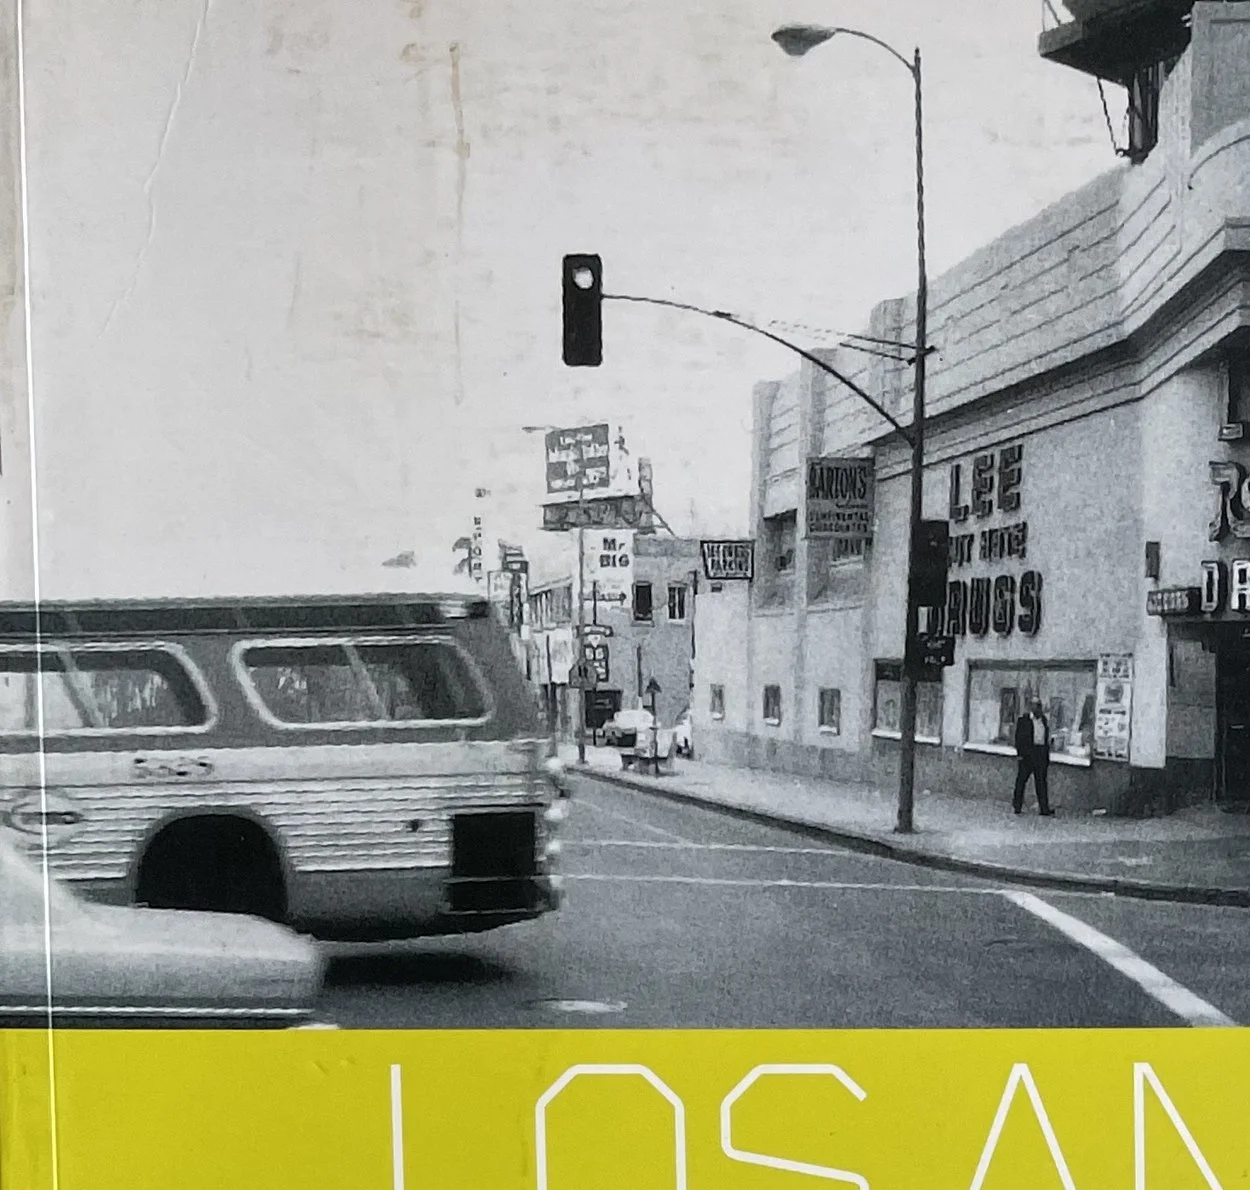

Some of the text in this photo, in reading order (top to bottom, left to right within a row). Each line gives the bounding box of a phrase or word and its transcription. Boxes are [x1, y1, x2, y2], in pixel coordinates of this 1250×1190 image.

[949, 444, 1024, 525] LEE
[603, 537, 626, 552] Mr
[600, 554, 630, 569] BIG
